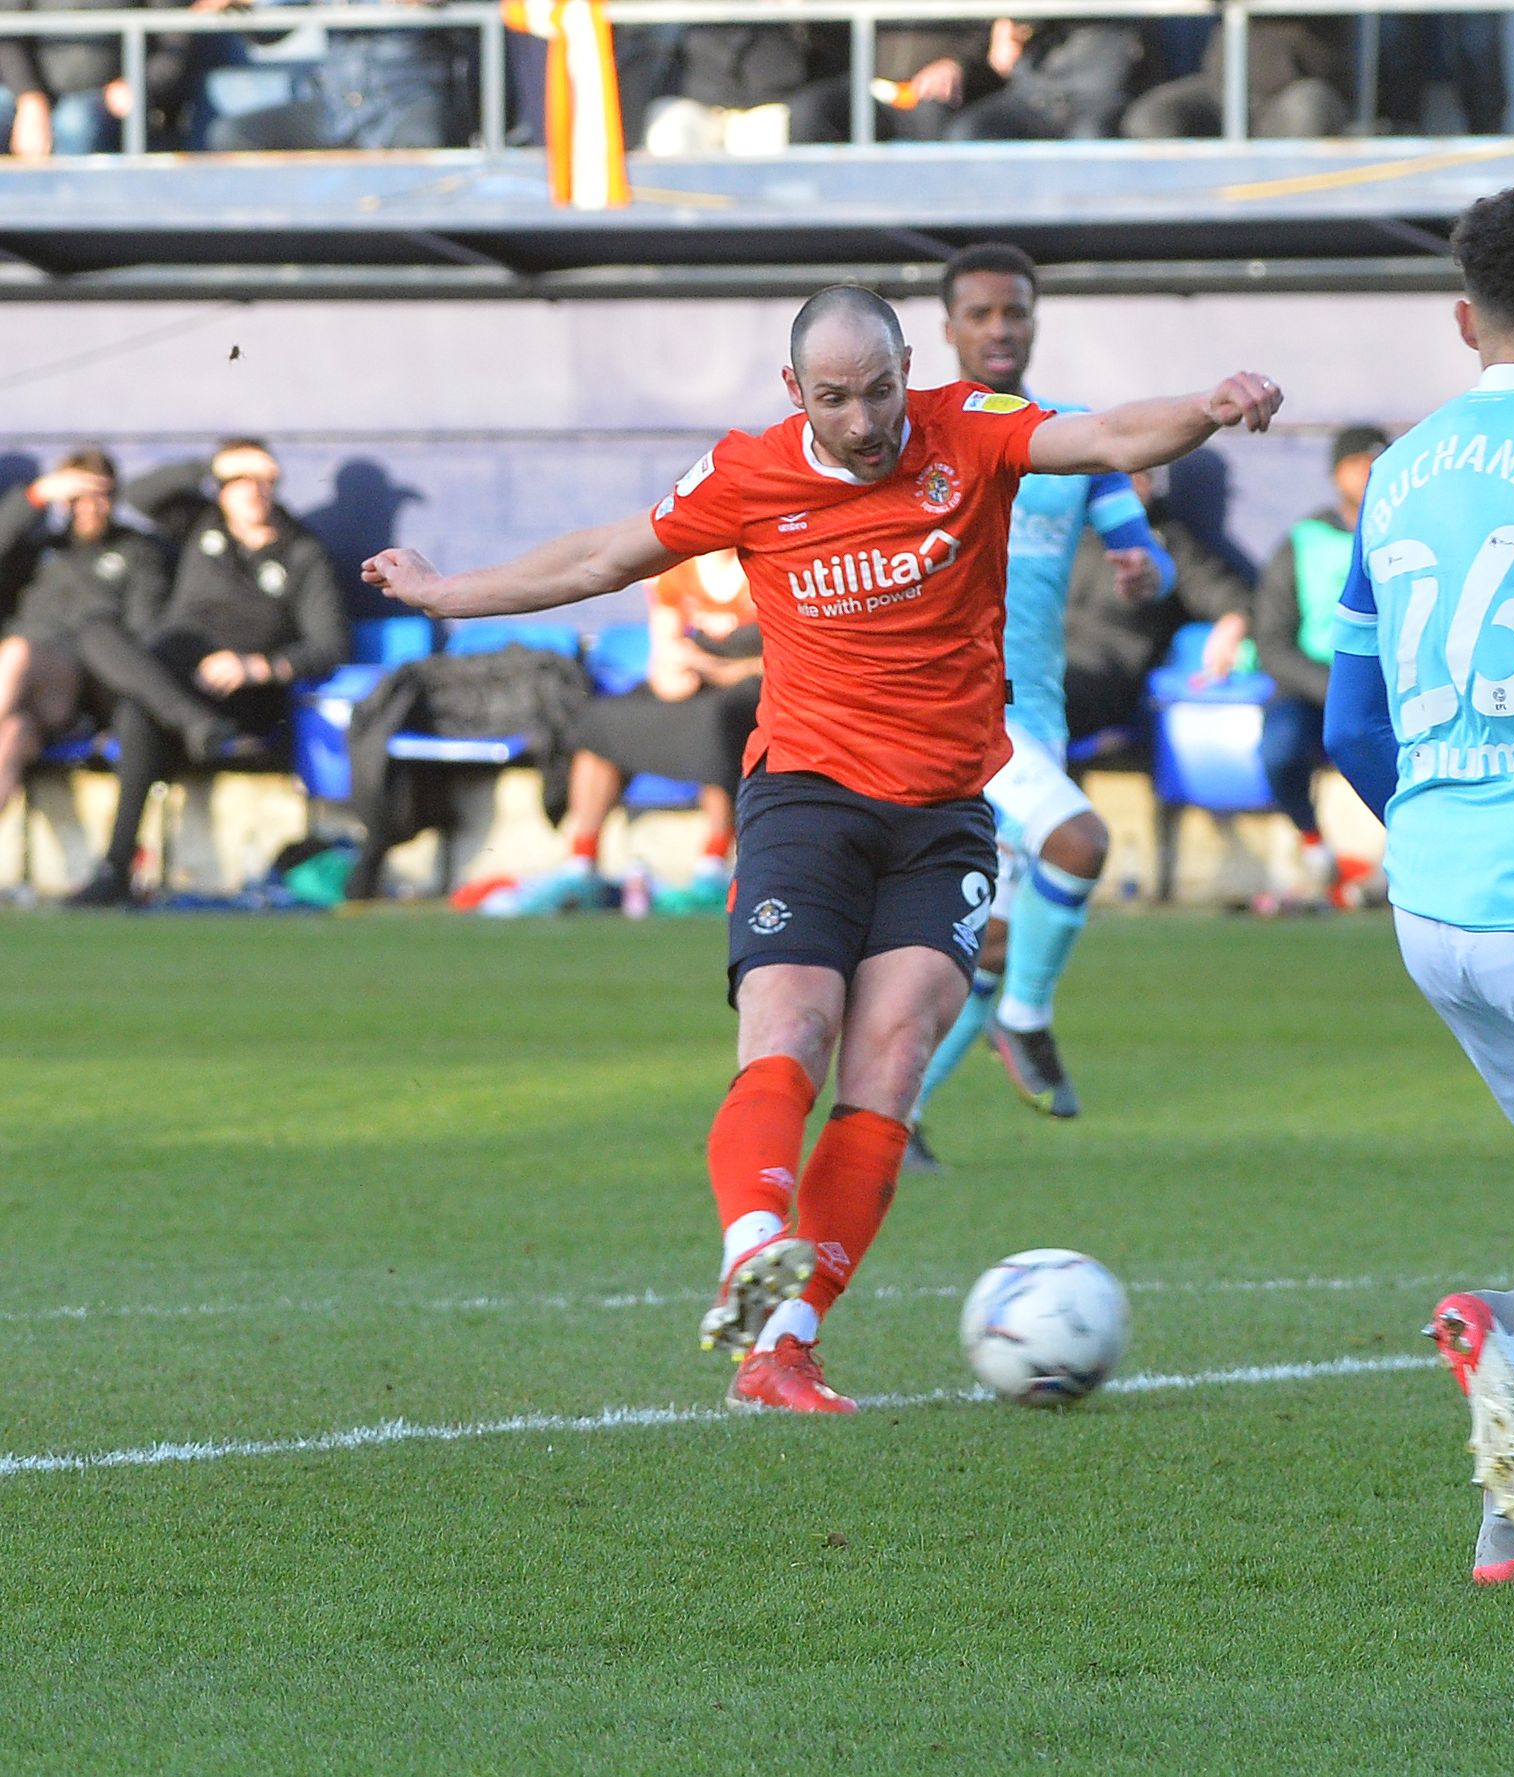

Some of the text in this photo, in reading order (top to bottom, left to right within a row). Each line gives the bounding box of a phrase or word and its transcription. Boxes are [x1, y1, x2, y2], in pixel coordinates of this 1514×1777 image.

[788, 548, 922, 600] utilita
[821, 596, 863, 618] with
[866, 584, 923, 613] power
